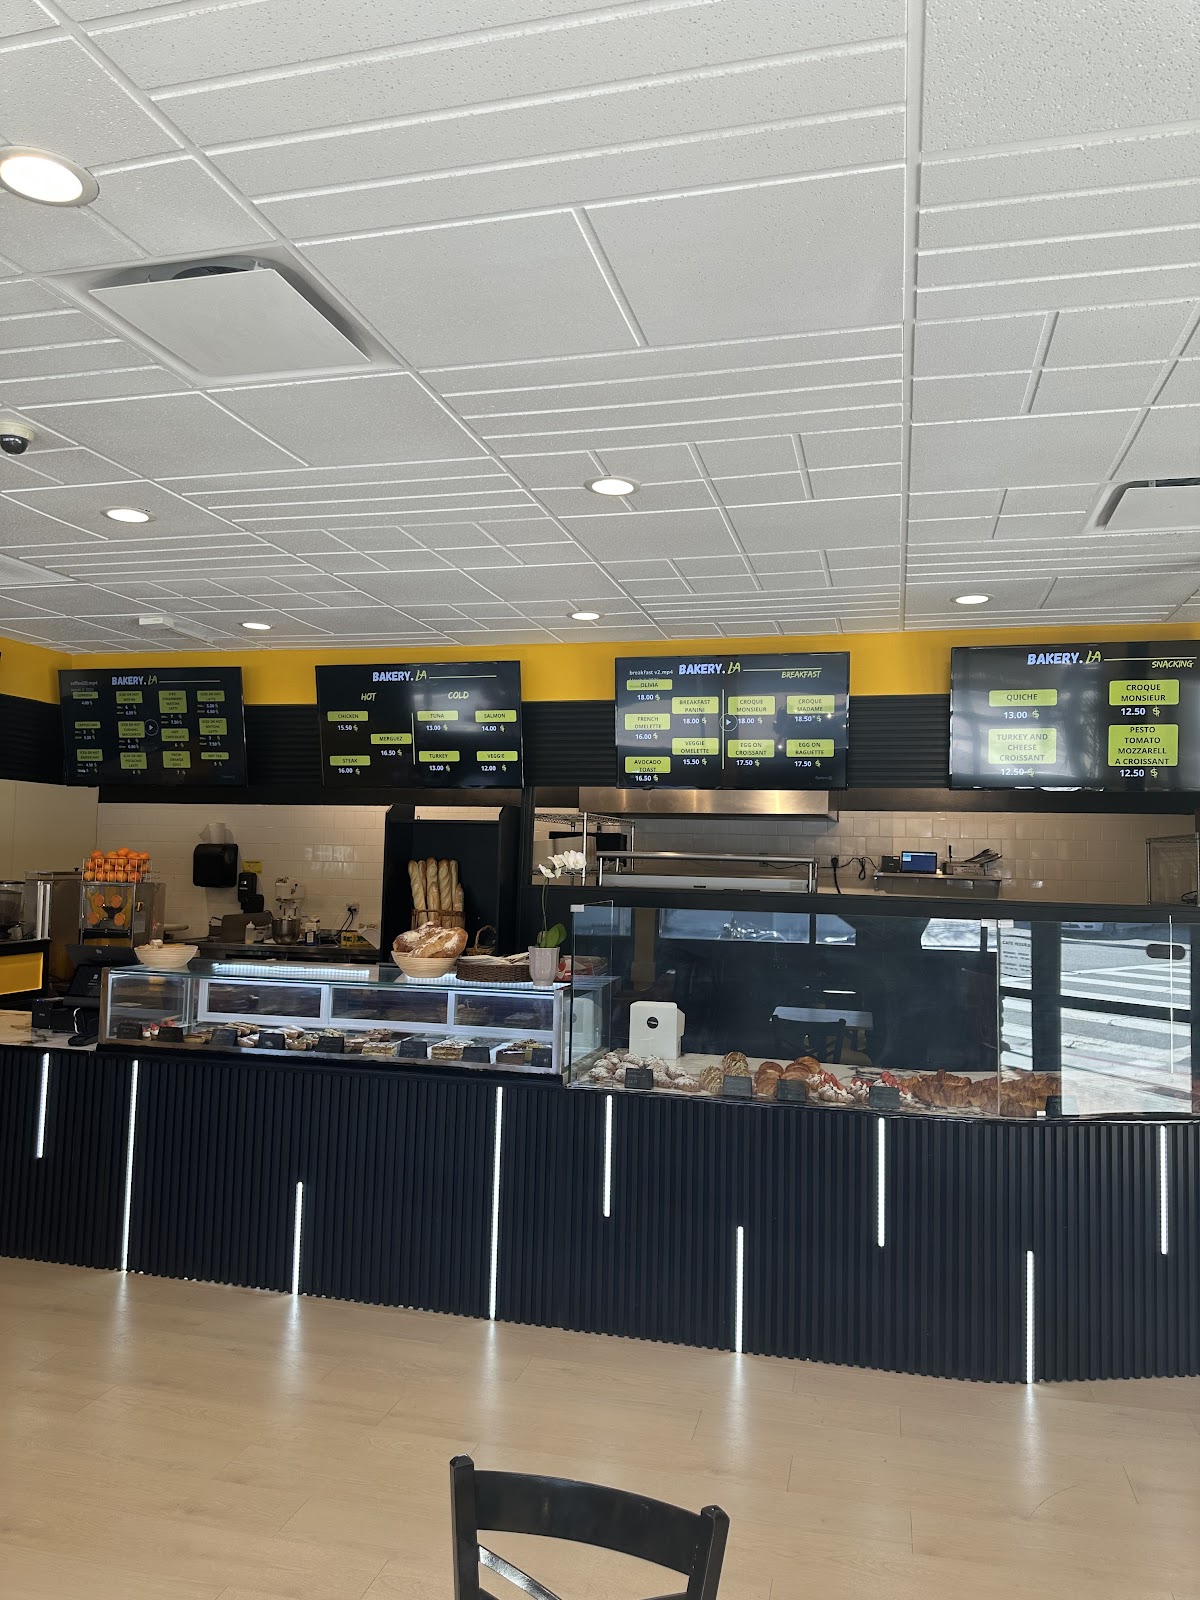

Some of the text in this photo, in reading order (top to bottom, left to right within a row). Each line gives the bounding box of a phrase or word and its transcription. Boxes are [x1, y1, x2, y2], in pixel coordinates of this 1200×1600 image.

[1151, 660, 1194, 669] SNACKING
[781, 670, 822, 679] BREAKFAST
[361, 692, 377, 702] HOT
[448, 691, 470, 700] COLD
